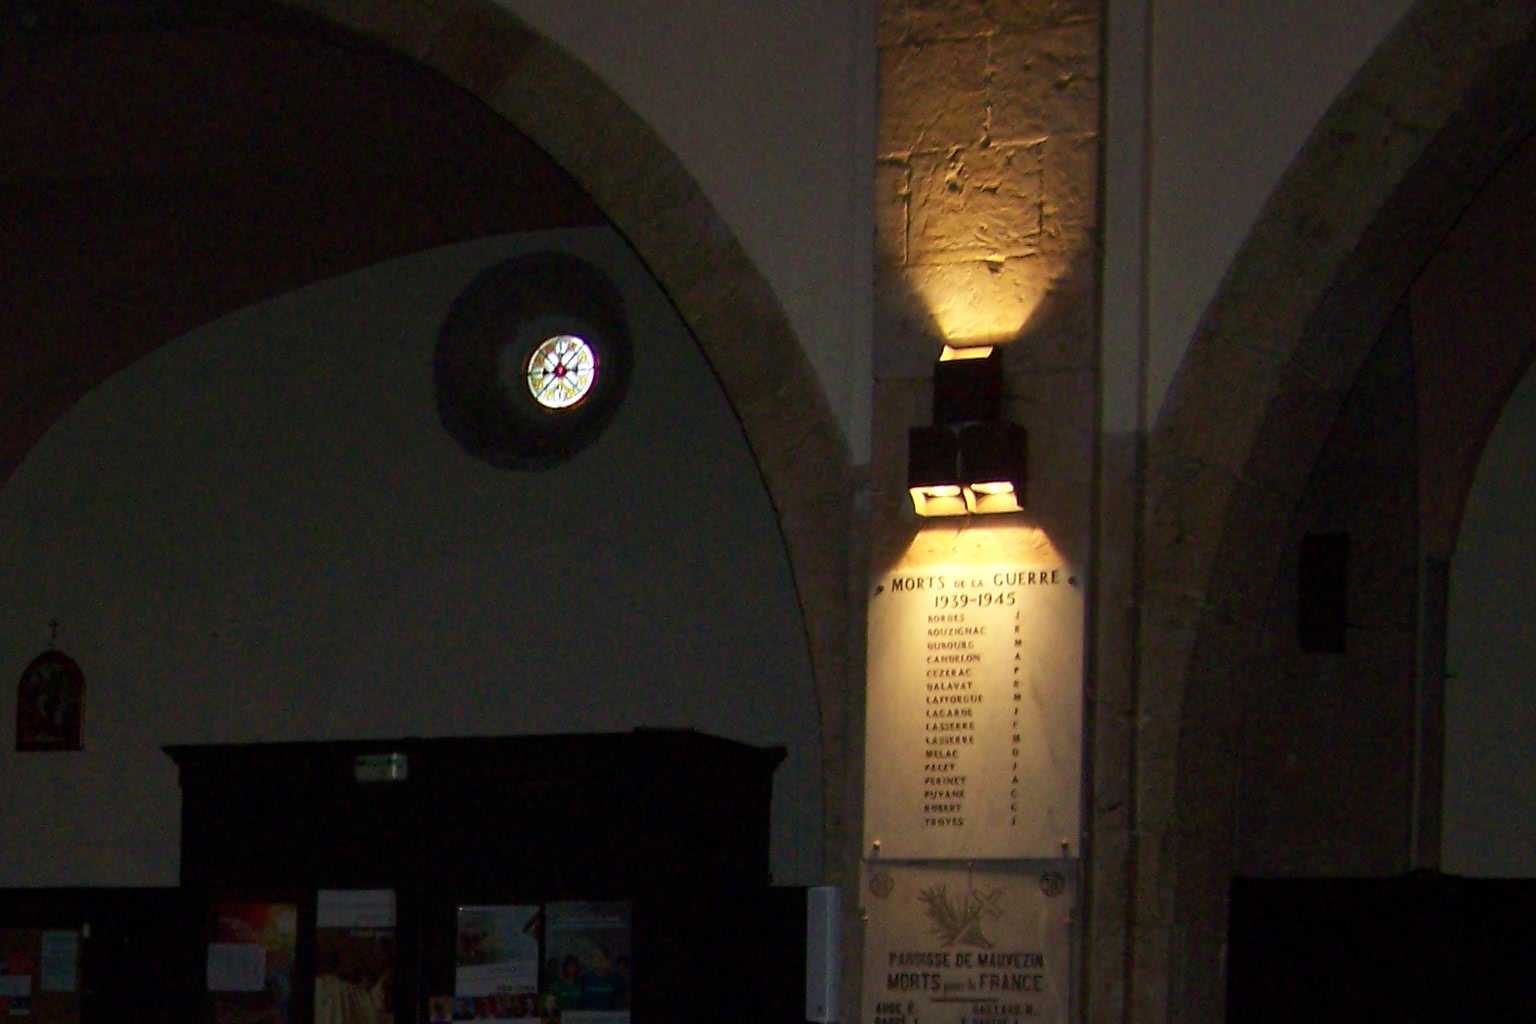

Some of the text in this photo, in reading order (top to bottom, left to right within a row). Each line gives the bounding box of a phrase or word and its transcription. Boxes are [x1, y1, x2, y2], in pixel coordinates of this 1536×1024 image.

[891, 569, 1060, 592] MORTS DE LA GUERRE
[934, 592, 1016, 608] 1939-1945
[928, 614, 964, 623] BORDES
[889, 952, 1043, 968] PAROISSE DE MAUVEZIN
[887, 973, 940, 991] MORTS
[979, 973, 1043, 991] FRANCE
